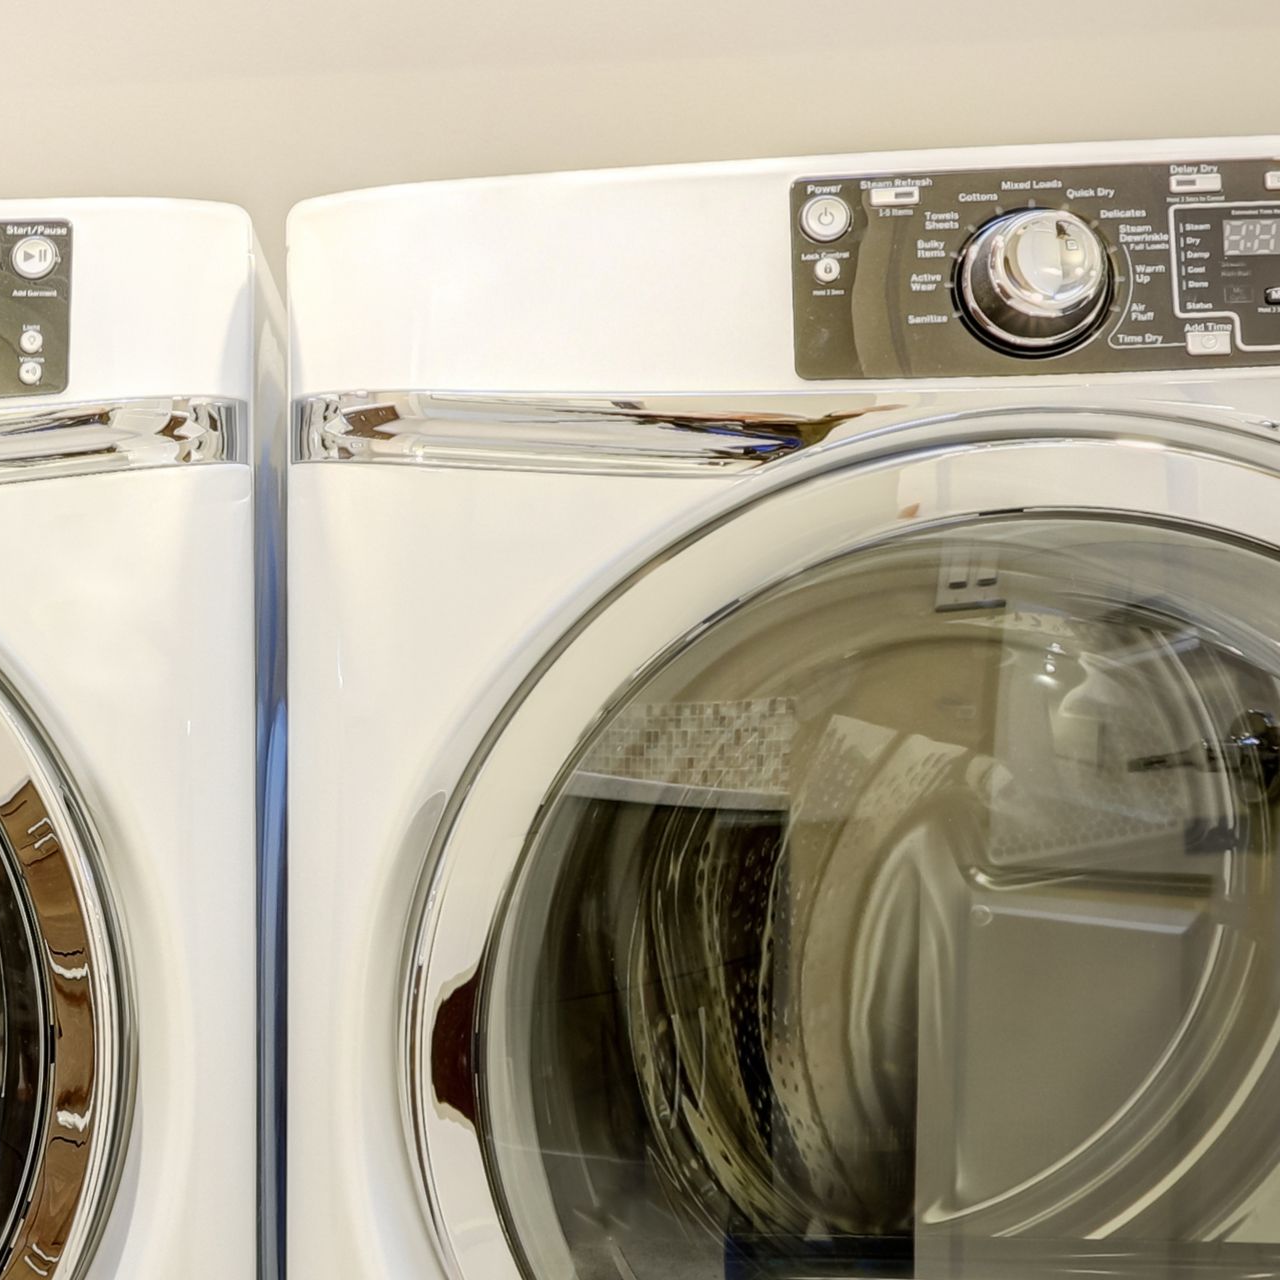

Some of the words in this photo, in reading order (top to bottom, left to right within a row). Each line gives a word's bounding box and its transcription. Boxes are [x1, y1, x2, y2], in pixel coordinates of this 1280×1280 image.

[1170, 165, 1198, 174] Delay
[1200, 164, 1218, 173] Dry
[860, 180, 893, 189] Steam
[894, 178, 932, 187] Refresh
[1001, 181, 1031, 190] Mixed
[1032, 179, 1062, 189] Loads
[807, 184, 842, 194] Power
[958, 193, 998, 202] Cottons
[1066, 188, 1095, 200] Quick
[1097, 188, 1115, 198] Dry
[895, 208, 913, 216] Items
[925, 212, 959, 220] Towels
[1100, 209, 1146, 218] Delicates
[925, 221, 959, 230] Sheets
[1119, 224, 1152, 233] Steam
[7, 226, 67, 235] Start/Pause
[1119, 233, 1169, 243] Dewrinkle
[1186, 237, 1200, 245] Dry
[917, 240, 944, 250] Bulky
[801, 253, 819, 261] Lock
[821, 251, 850, 259] Control
[917, 249, 945, 258] Items
[1186, 251, 1209, 259] Damp
[1135, 265, 1165, 273] Warm
[910, 273, 941, 282] Active
[1136, 274, 1150, 283] Up
[910, 283, 936, 291] Wear
[1131, 303, 1145, 311] Air
[908, 315, 947, 324] Sanitize
[1131, 312, 1154, 321] Fluff
[1184, 323, 1204, 332] Add
[1206, 323, 1232, 331] Time
[1118, 334, 1143, 343] Time
[1145, 334, 1163, 344] Dry
